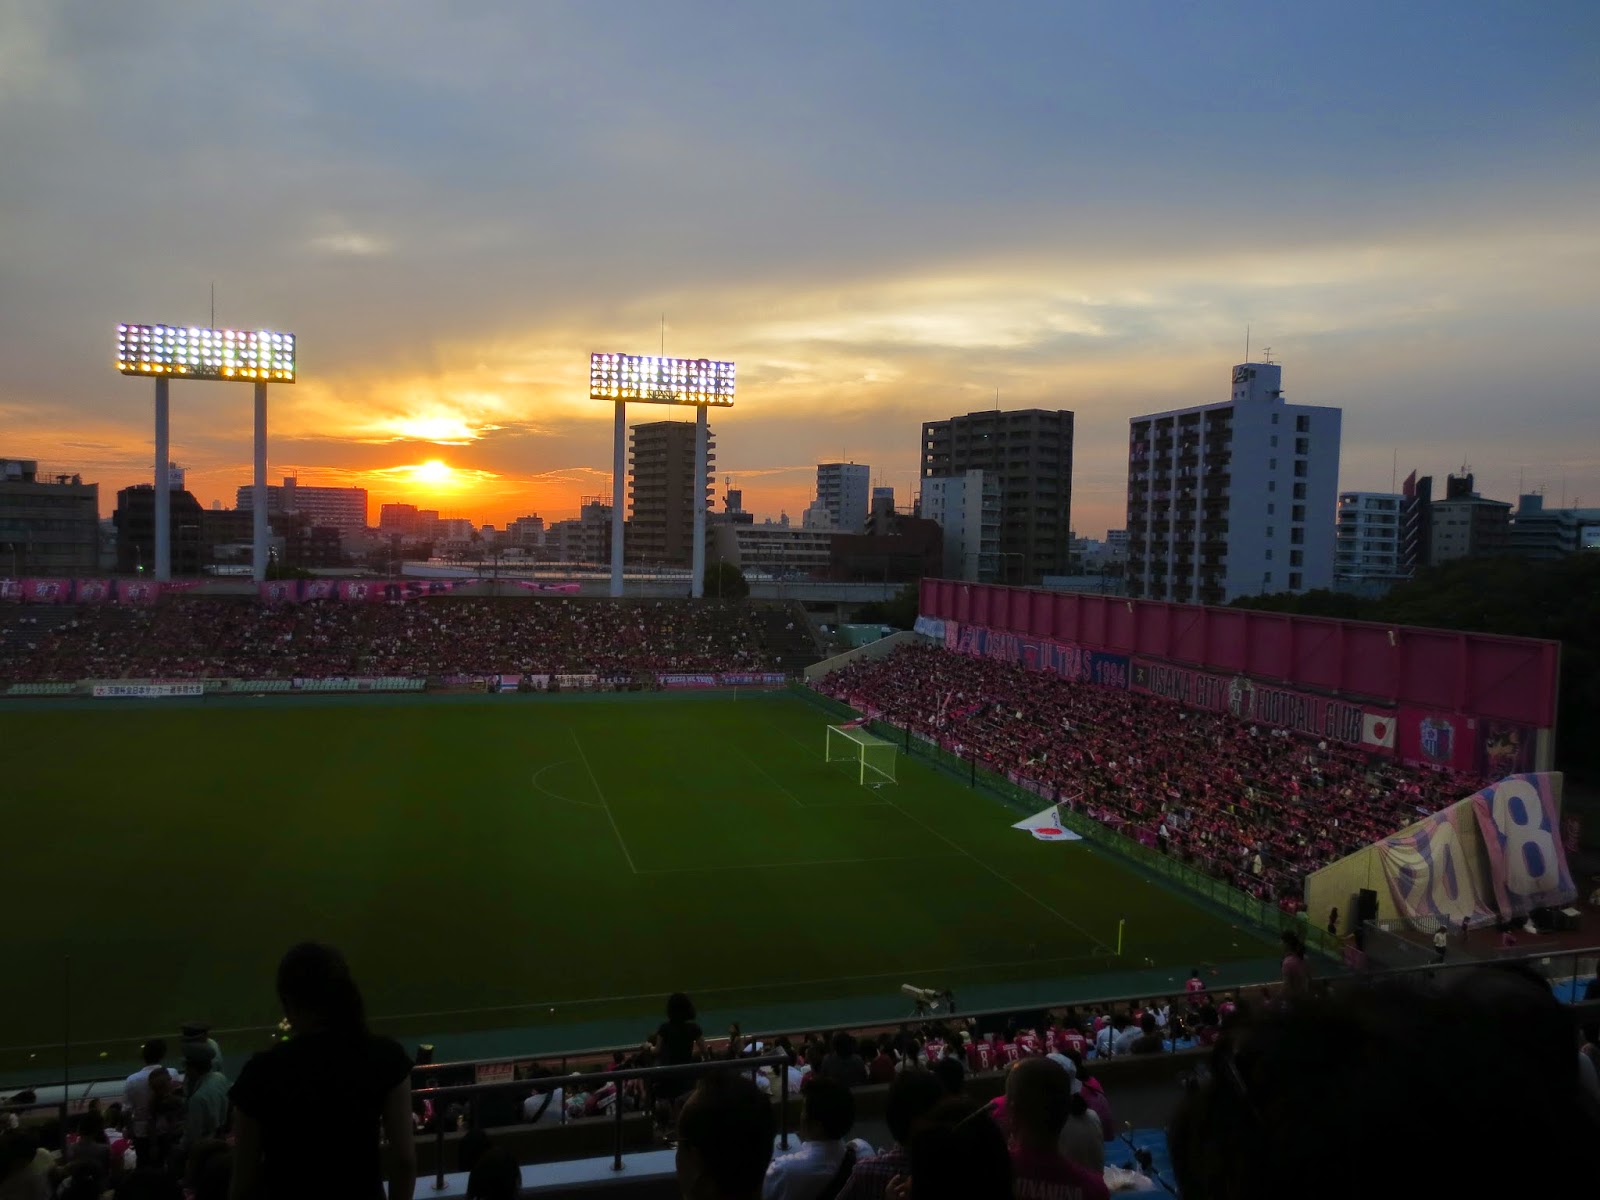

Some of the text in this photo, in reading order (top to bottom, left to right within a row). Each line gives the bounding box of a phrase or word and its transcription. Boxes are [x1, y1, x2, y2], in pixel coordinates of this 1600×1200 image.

[1096, 660, 1126, 688] 1994
[1150, 665, 1364, 745] OSAKA CITY FOOTBALL CLUB
[1493, 780, 1558, 895] 8
